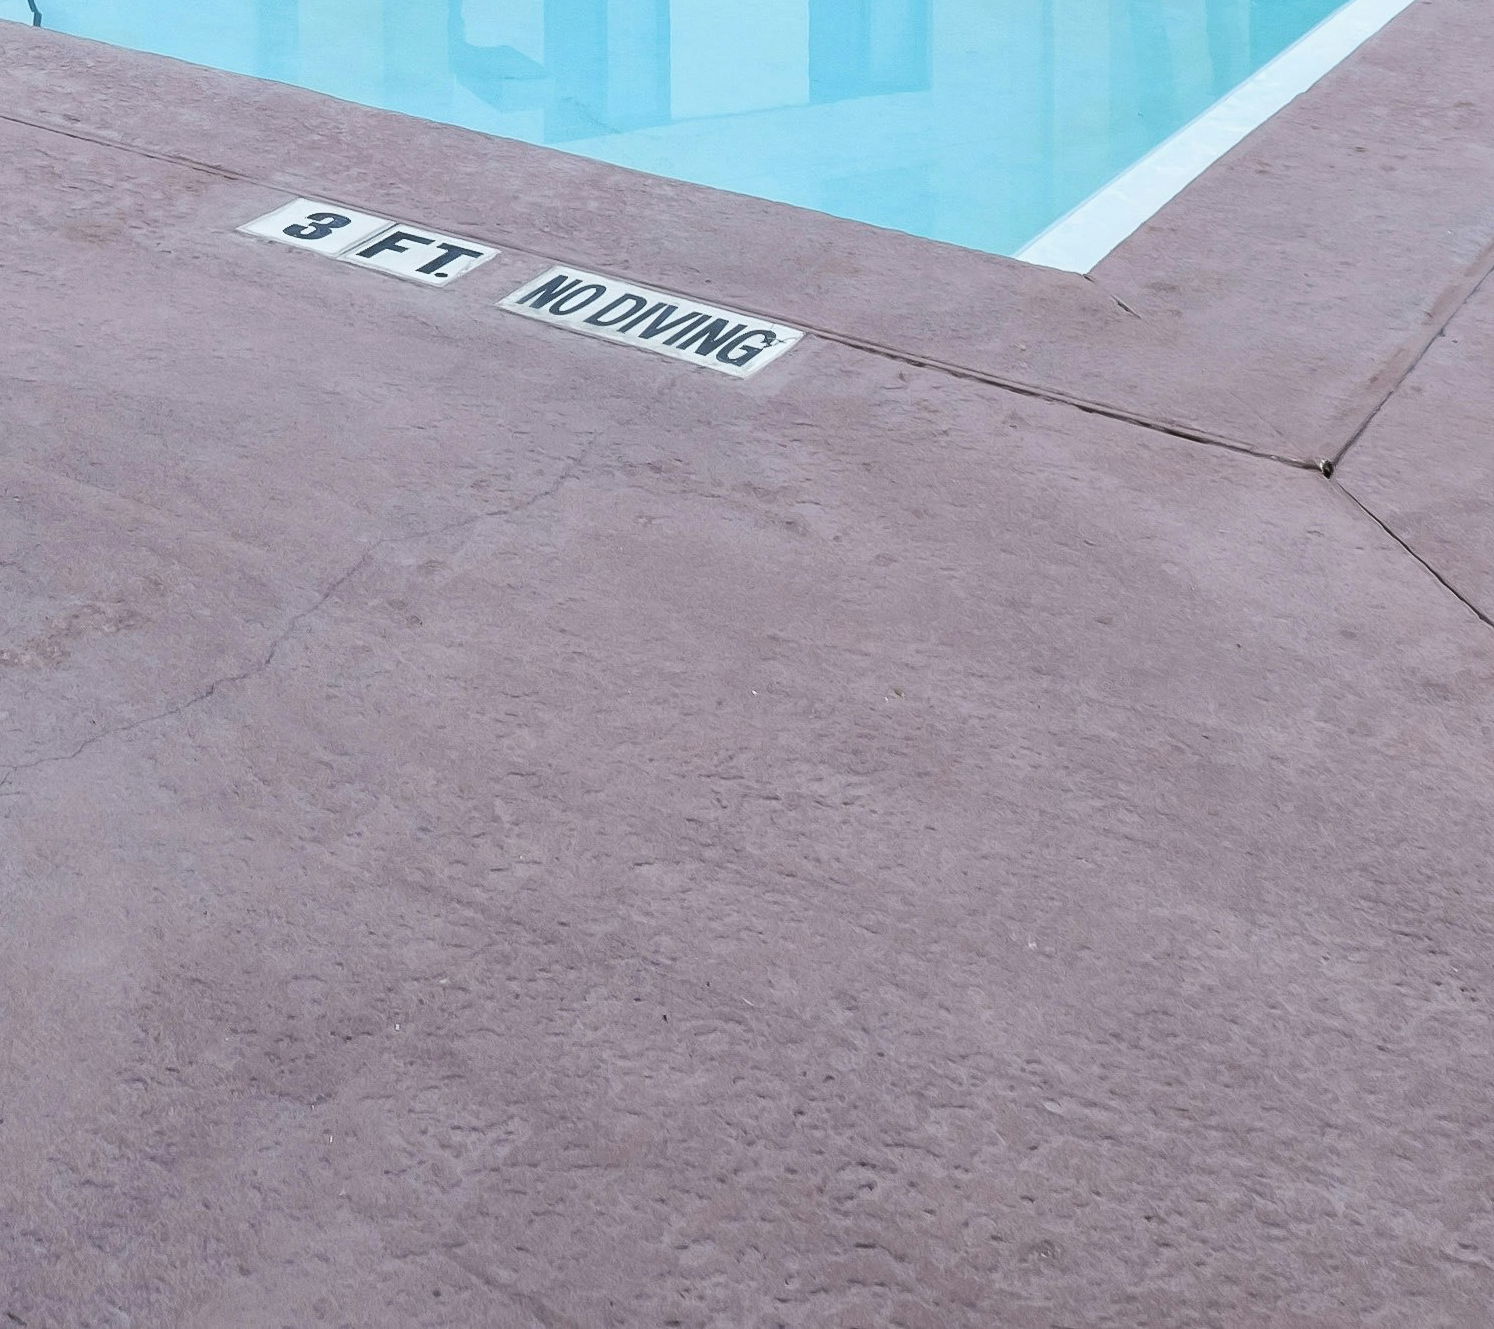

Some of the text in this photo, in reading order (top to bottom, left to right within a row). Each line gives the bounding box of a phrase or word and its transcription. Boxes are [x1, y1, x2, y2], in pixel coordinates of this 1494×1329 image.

[281, 210, 483, 279] 3 FT.
[515, 274, 778, 368] NO DIVING
